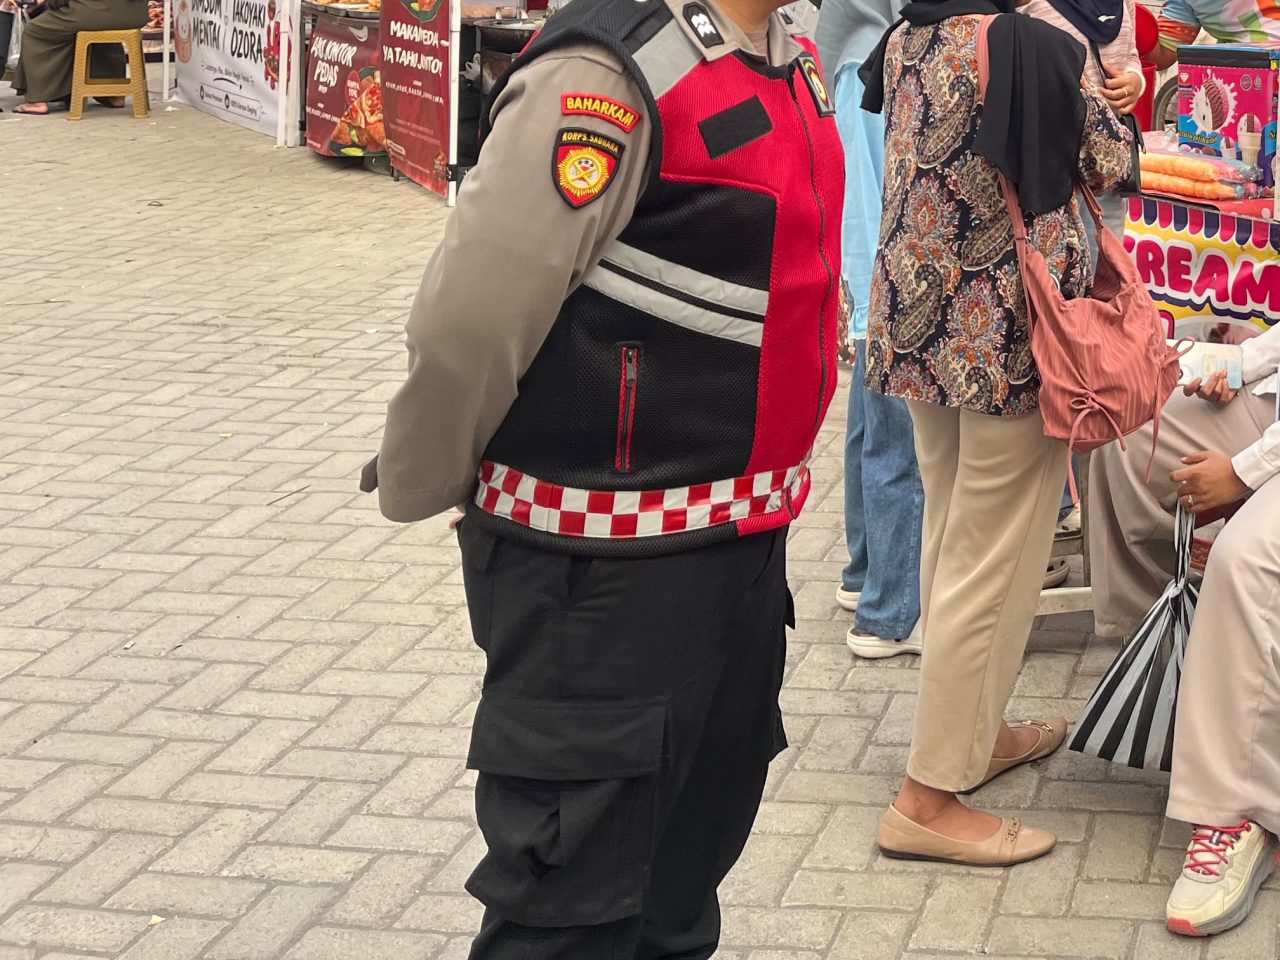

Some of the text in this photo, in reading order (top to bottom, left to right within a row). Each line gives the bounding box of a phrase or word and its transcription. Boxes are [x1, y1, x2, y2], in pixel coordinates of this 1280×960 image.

[192, 17, 263, 64] MENTAI OZORA
[324, 40, 357, 68] JONTOR
[383, 45, 394, 64] YA
[394, 46, 418, 69] TAHU
[313, 60, 340, 88] PEDAS
[566, 96, 635, 127] BAHARKAM
[562, 132, 587, 142] KORPS
